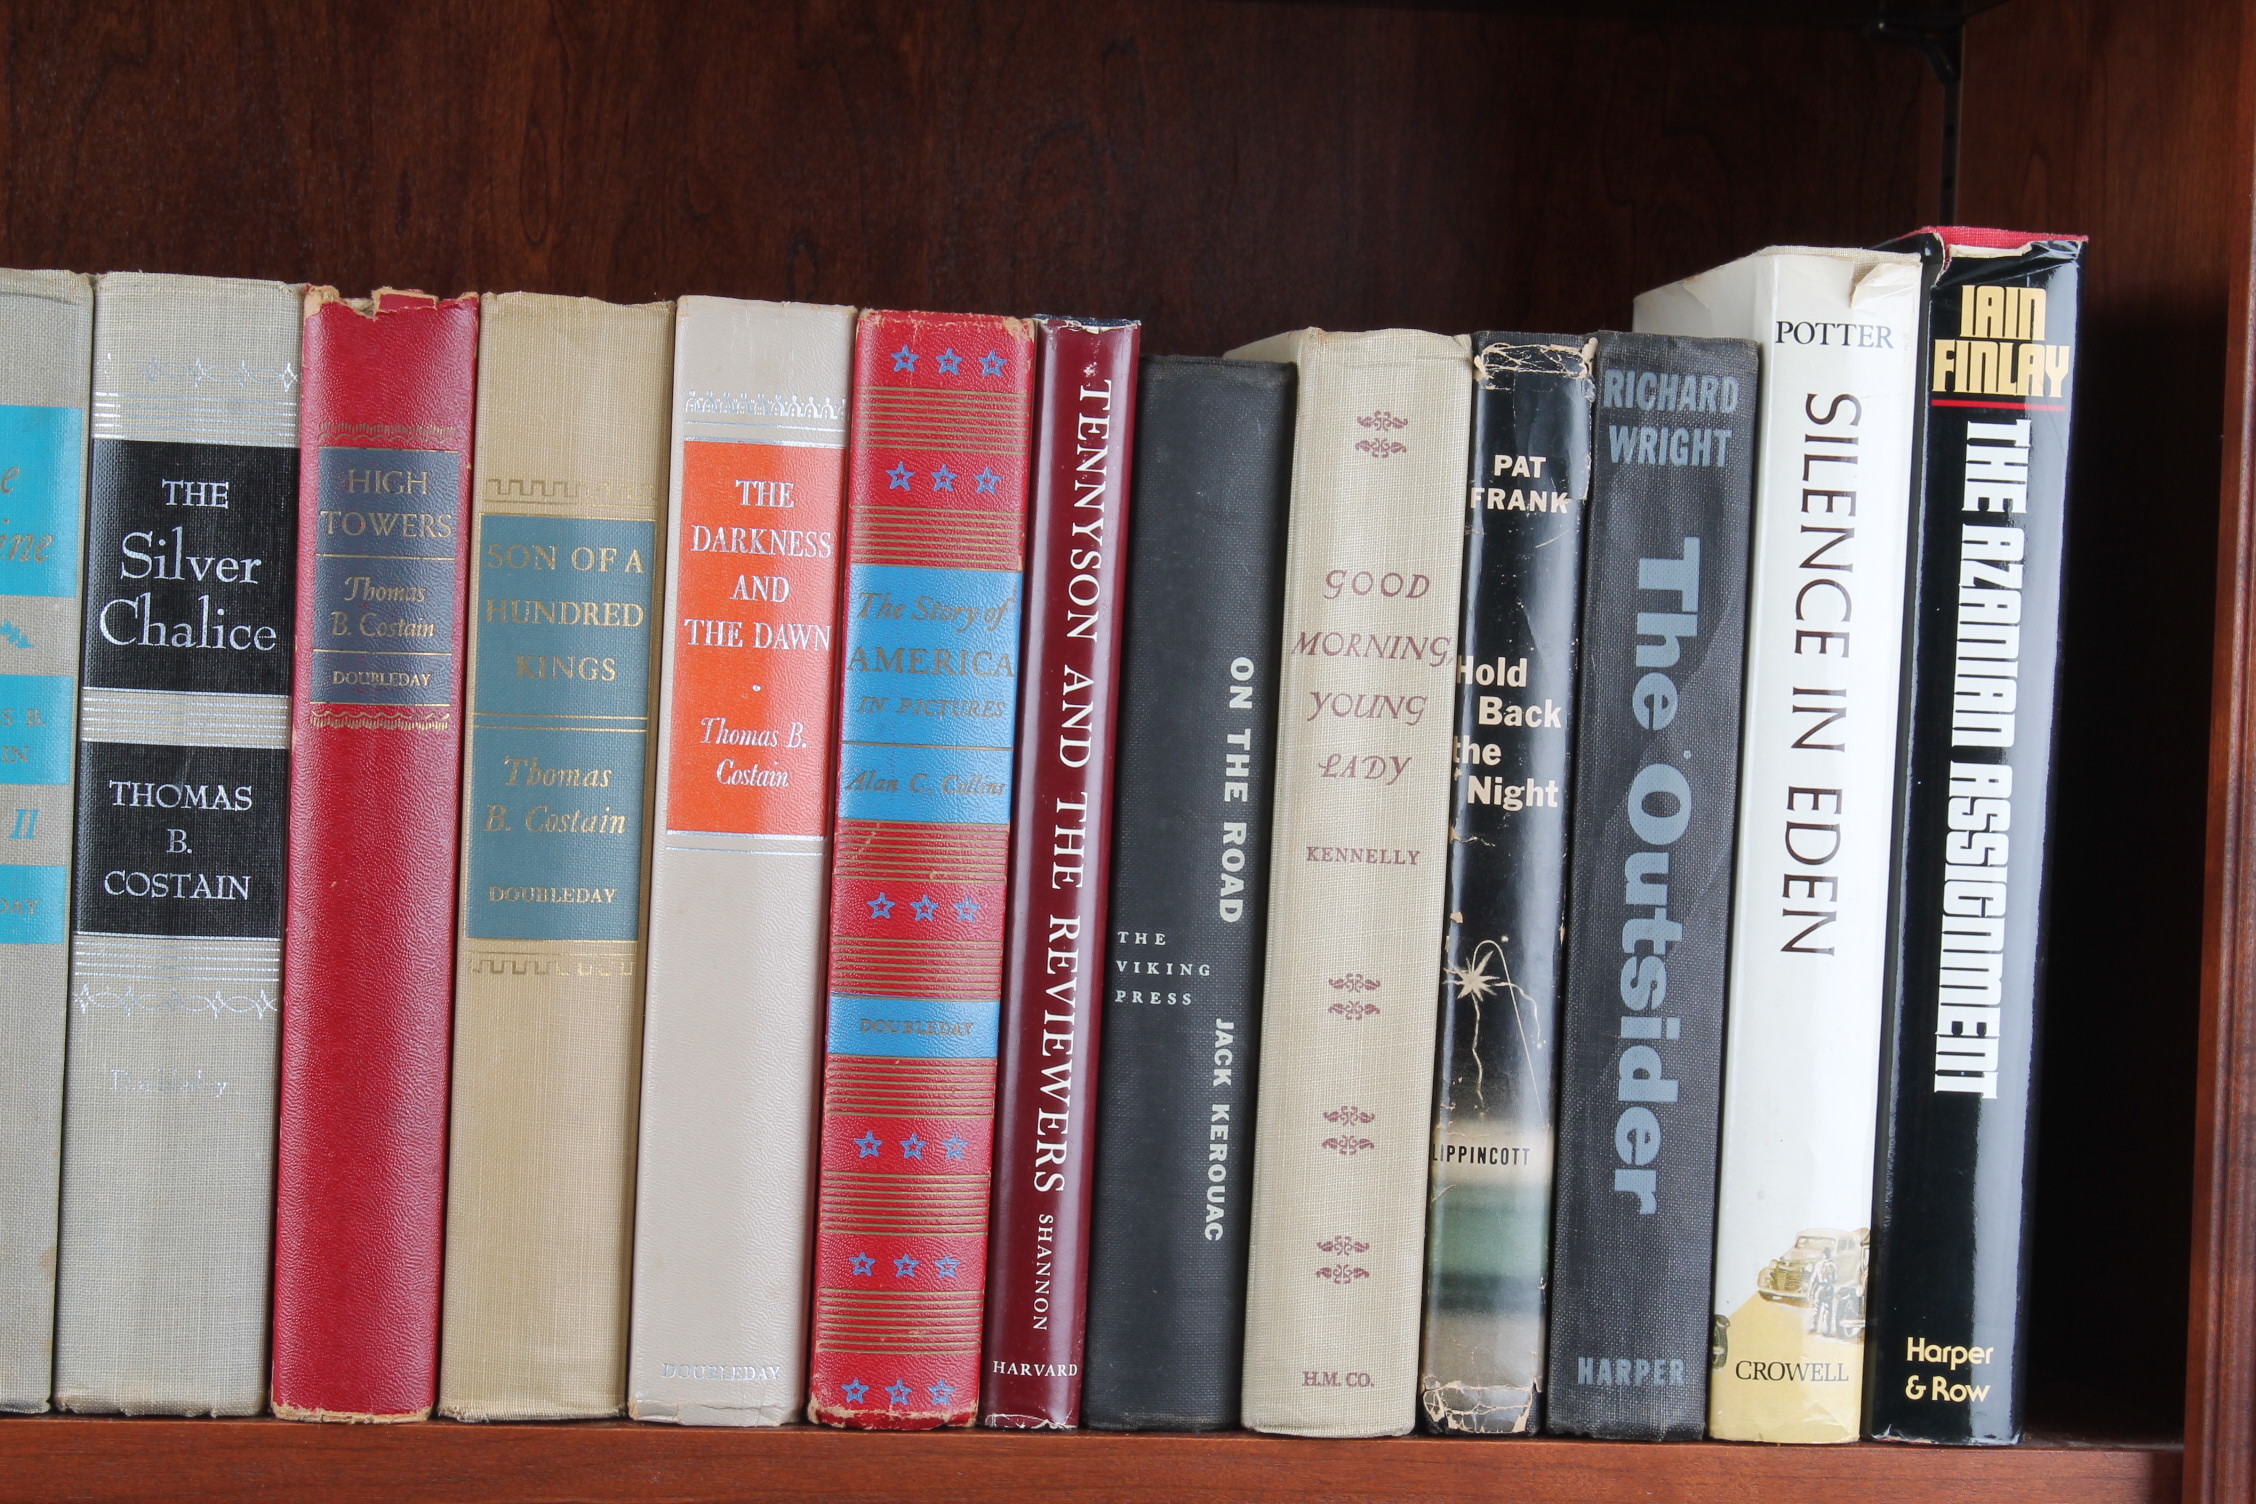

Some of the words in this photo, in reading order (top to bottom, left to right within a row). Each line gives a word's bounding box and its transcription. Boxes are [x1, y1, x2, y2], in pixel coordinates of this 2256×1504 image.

[1960, 285, 2046, 341] IAIN
[1774, 320, 1894, 349] POTTER
[1932, 340, 2070, 398] FINLAY
[1603, 369, 1739, 413] RICHARD
[1608, 426, 1732, 468] WRIGHT
[1494, 454, 1546, 478] PAT
[1962, 418, 2031, 514] THE
[162, 479, 229, 508] THE
[348, 469, 429, 495] HIGH
[735, 479, 794, 509] THE
[1067, 379, 1112, 642] TENNYSON
[1470, 487, 1568, 514] FRANK
[322, 510, 453, 538] TOWERS
[1794, 393, 1862, 658] SILENCE
[120, 526, 261, 584] Silver
[690, 525, 832, 559] DARKNESS
[487, 546, 557, 573] SON
[571, 548, 619, 573] OF
[623, 549, 643, 573] A
[344, 576, 427, 603] Thomas
[730, 575, 790, 604] AND
[1323, 569, 1430, 600] GOOD
[99, 592, 277, 650] Chalice
[332, 612, 353, 636] B.
[360, 613, 436, 638] Costain
[486, 600, 644, 627] HUNDRED
[858, 592, 906, 619] The
[911, 596, 979, 633] Story
[984, 597, 1016, 631] of
[684, 618, 744, 649] THE
[754, 621, 832, 652] DAWN
[1291, 631, 1453, 667] MORNING,
[1631, 536, 1700, 731] The
[1951, 523, 2025, 748] AZANIAN
[517, 655, 617, 682] KINGS
[847, 647, 1014, 677] AMERICA
[1456, 655, 1528, 688] Hold
[332, 670, 430, 689] DOUBLEDAY
[1230, 657, 1254, 709] ON
[26, 708, 47, 726] B.
[858, 697, 889, 713] IN
[897, 698, 1006, 718] PICTURES
[1059, 667, 1094, 768] AND
[1307, 691, 1428, 726] YOUNG
[1478, 696, 1561, 728] Back
[1790, 687, 1847, 753] IN
[700, 717, 779, 748] Thomas
[789, 722, 807, 748] B.
[1223, 727, 1251, 803] THE
[1452, 735, 1501, 765] the
[504, 756, 611, 789] Thomas
[716, 759, 790, 788] Costain
[845, 771, 898, 792] Alan
[910, 773, 932, 793] C.
[941, 775, 1005, 795] Collins
[1318, 753, 1412, 785] LADY
[109, 779, 253, 811] THOMAS
[1467, 776, 1559, 811] Night
[9, 808, 39, 839] II
[485, 805, 516, 832] B.
[526, 806, 626, 835] Costain
[167, 829, 192, 854] B.
[1052, 790, 1088, 890] THE
[1306, 846, 1421, 865] KENNELLY
[104, 869, 250, 900] COSTAIN
[1219, 821, 1247, 923] ROAD
[1781, 785, 1842, 956] EDEN
[488, 885, 617, 903] DOUBLEDAY
[1118, 931, 1167, 946] THE
[1933, 760, 2012, 1099] ASSIGNMENT
[1116, 960, 1211, 977] VIKING
[1115, 989, 1192, 1005] PRESS
[1614, 763, 1692, 1214] Outsider
[860, 1018, 974, 1036] DOUBLEDAY
[1034, 914, 1081, 1193] REVIEWERS
[1212, 1017, 1235, 1087] JACK
[1432, 1144, 1530, 1165] LIPPINCOTT
[1203, 1102, 1230, 1241] KEROUAC
[1033, 1213, 1054, 1331] SHANNON
[1906, 1336, 1994, 1370] Harper
[661, 1363, 780, 1380] DOUBLEDAY
[993, 1360, 1078, 1378] HARVARD
[1302, 1371, 1341, 1387] H.M.
[1345, 1372, 1375, 1388] CO.
[1578, 1356, 1684, 1387] HARPER
[1735, 1360, 1849, 1383] CROWELL
[1905, 1376, 1927, 1399] &
[1931, 1375, 1991, 1403] Row
